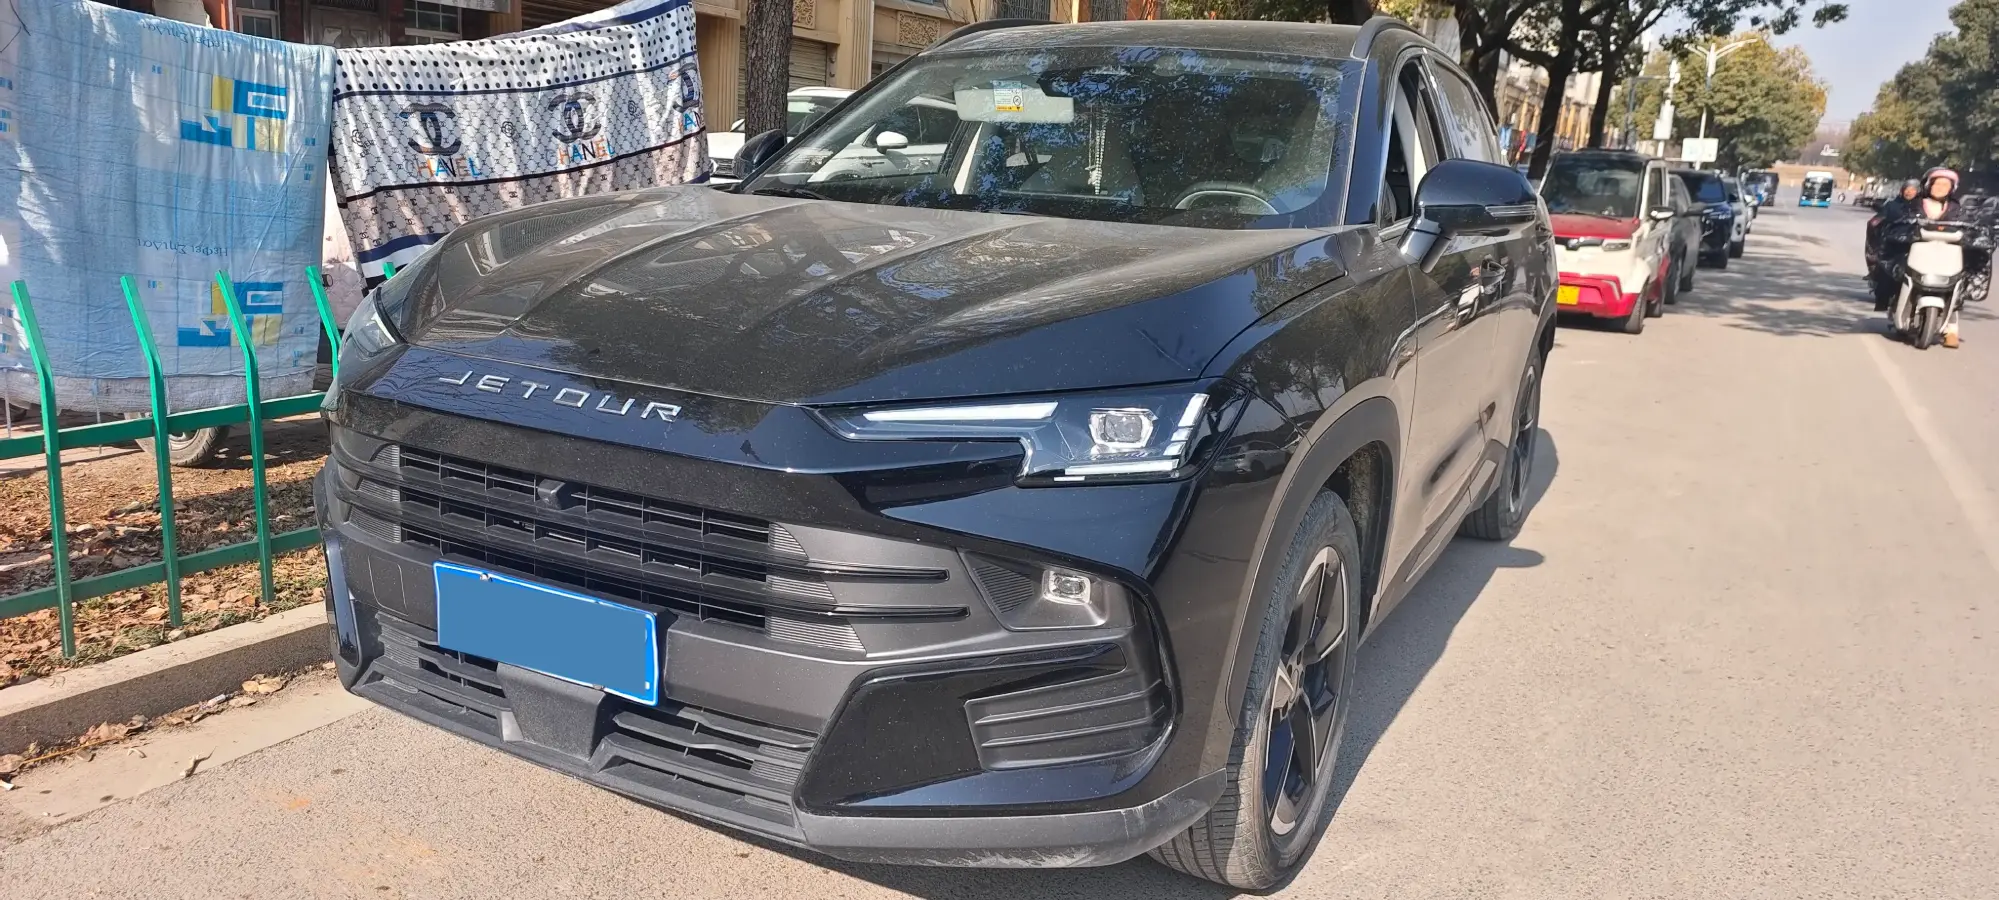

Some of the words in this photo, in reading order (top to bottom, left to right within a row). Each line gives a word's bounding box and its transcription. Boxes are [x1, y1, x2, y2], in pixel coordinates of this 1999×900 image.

[546, 137, 616, 166] CHANEL
[404, 156, 481, 178] CHANEL
[439, 370, 682, 423] JETOUR
